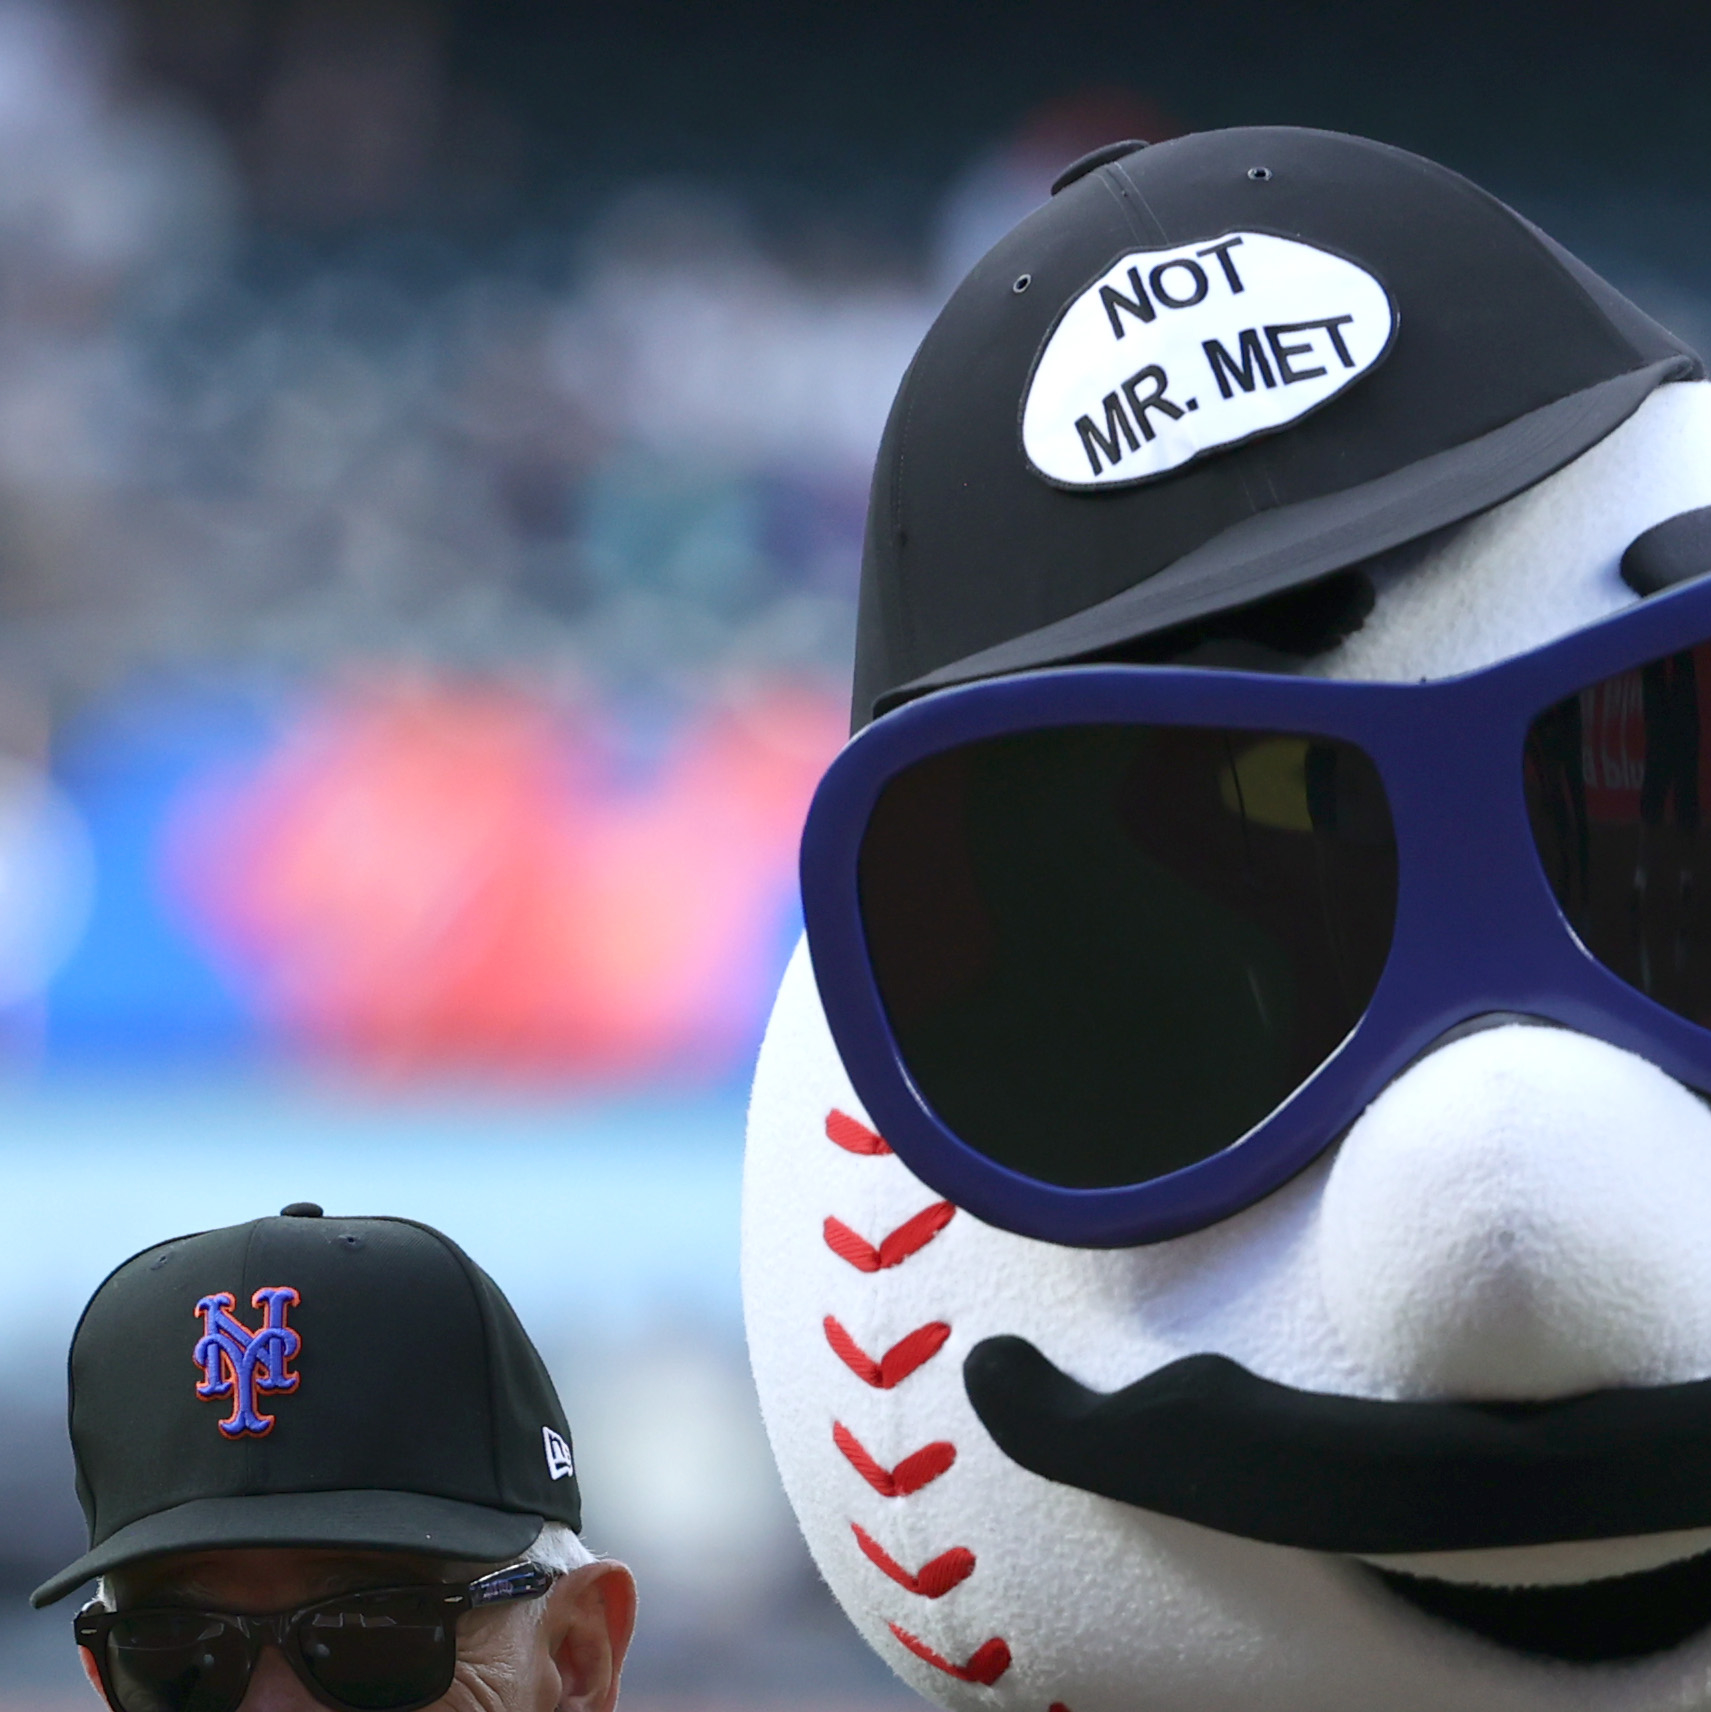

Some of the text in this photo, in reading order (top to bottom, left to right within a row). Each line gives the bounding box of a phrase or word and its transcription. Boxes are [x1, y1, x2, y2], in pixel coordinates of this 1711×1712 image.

[1098, 236, 1246, 340] NOT
[1074, 314, 1358, 477] MR. MET
[193, 1285, 302, 1440] NY
